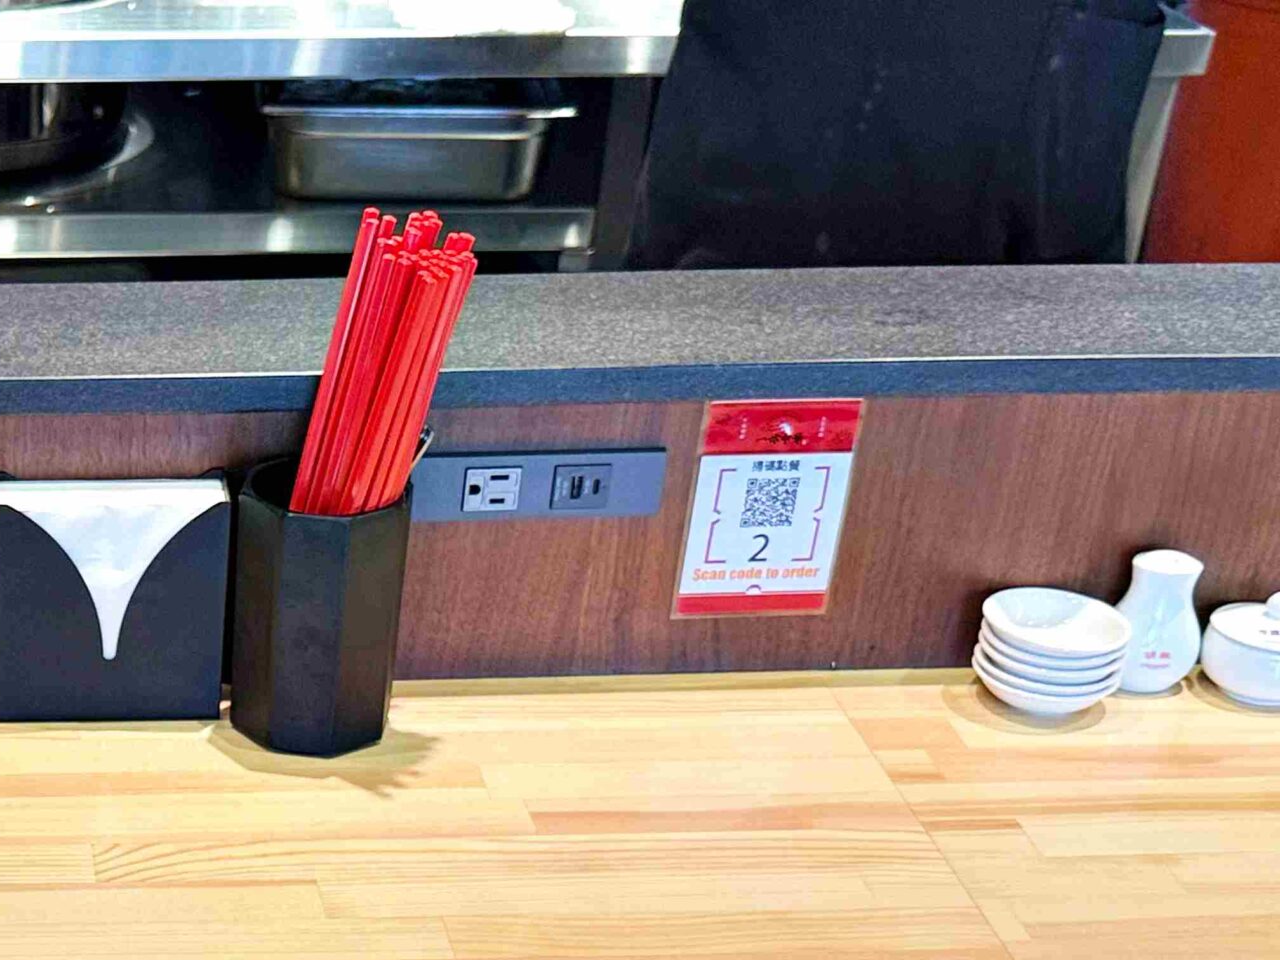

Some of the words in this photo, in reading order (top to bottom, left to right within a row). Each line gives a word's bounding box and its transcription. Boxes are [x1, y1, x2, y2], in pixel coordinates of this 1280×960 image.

[747, 533, 770, 562] 2
[692, 568, 726, 581] Scan
[729, 567, 762, 580] code
[766, 567, 779, 579] to
[783, 566, 820, 579] order
